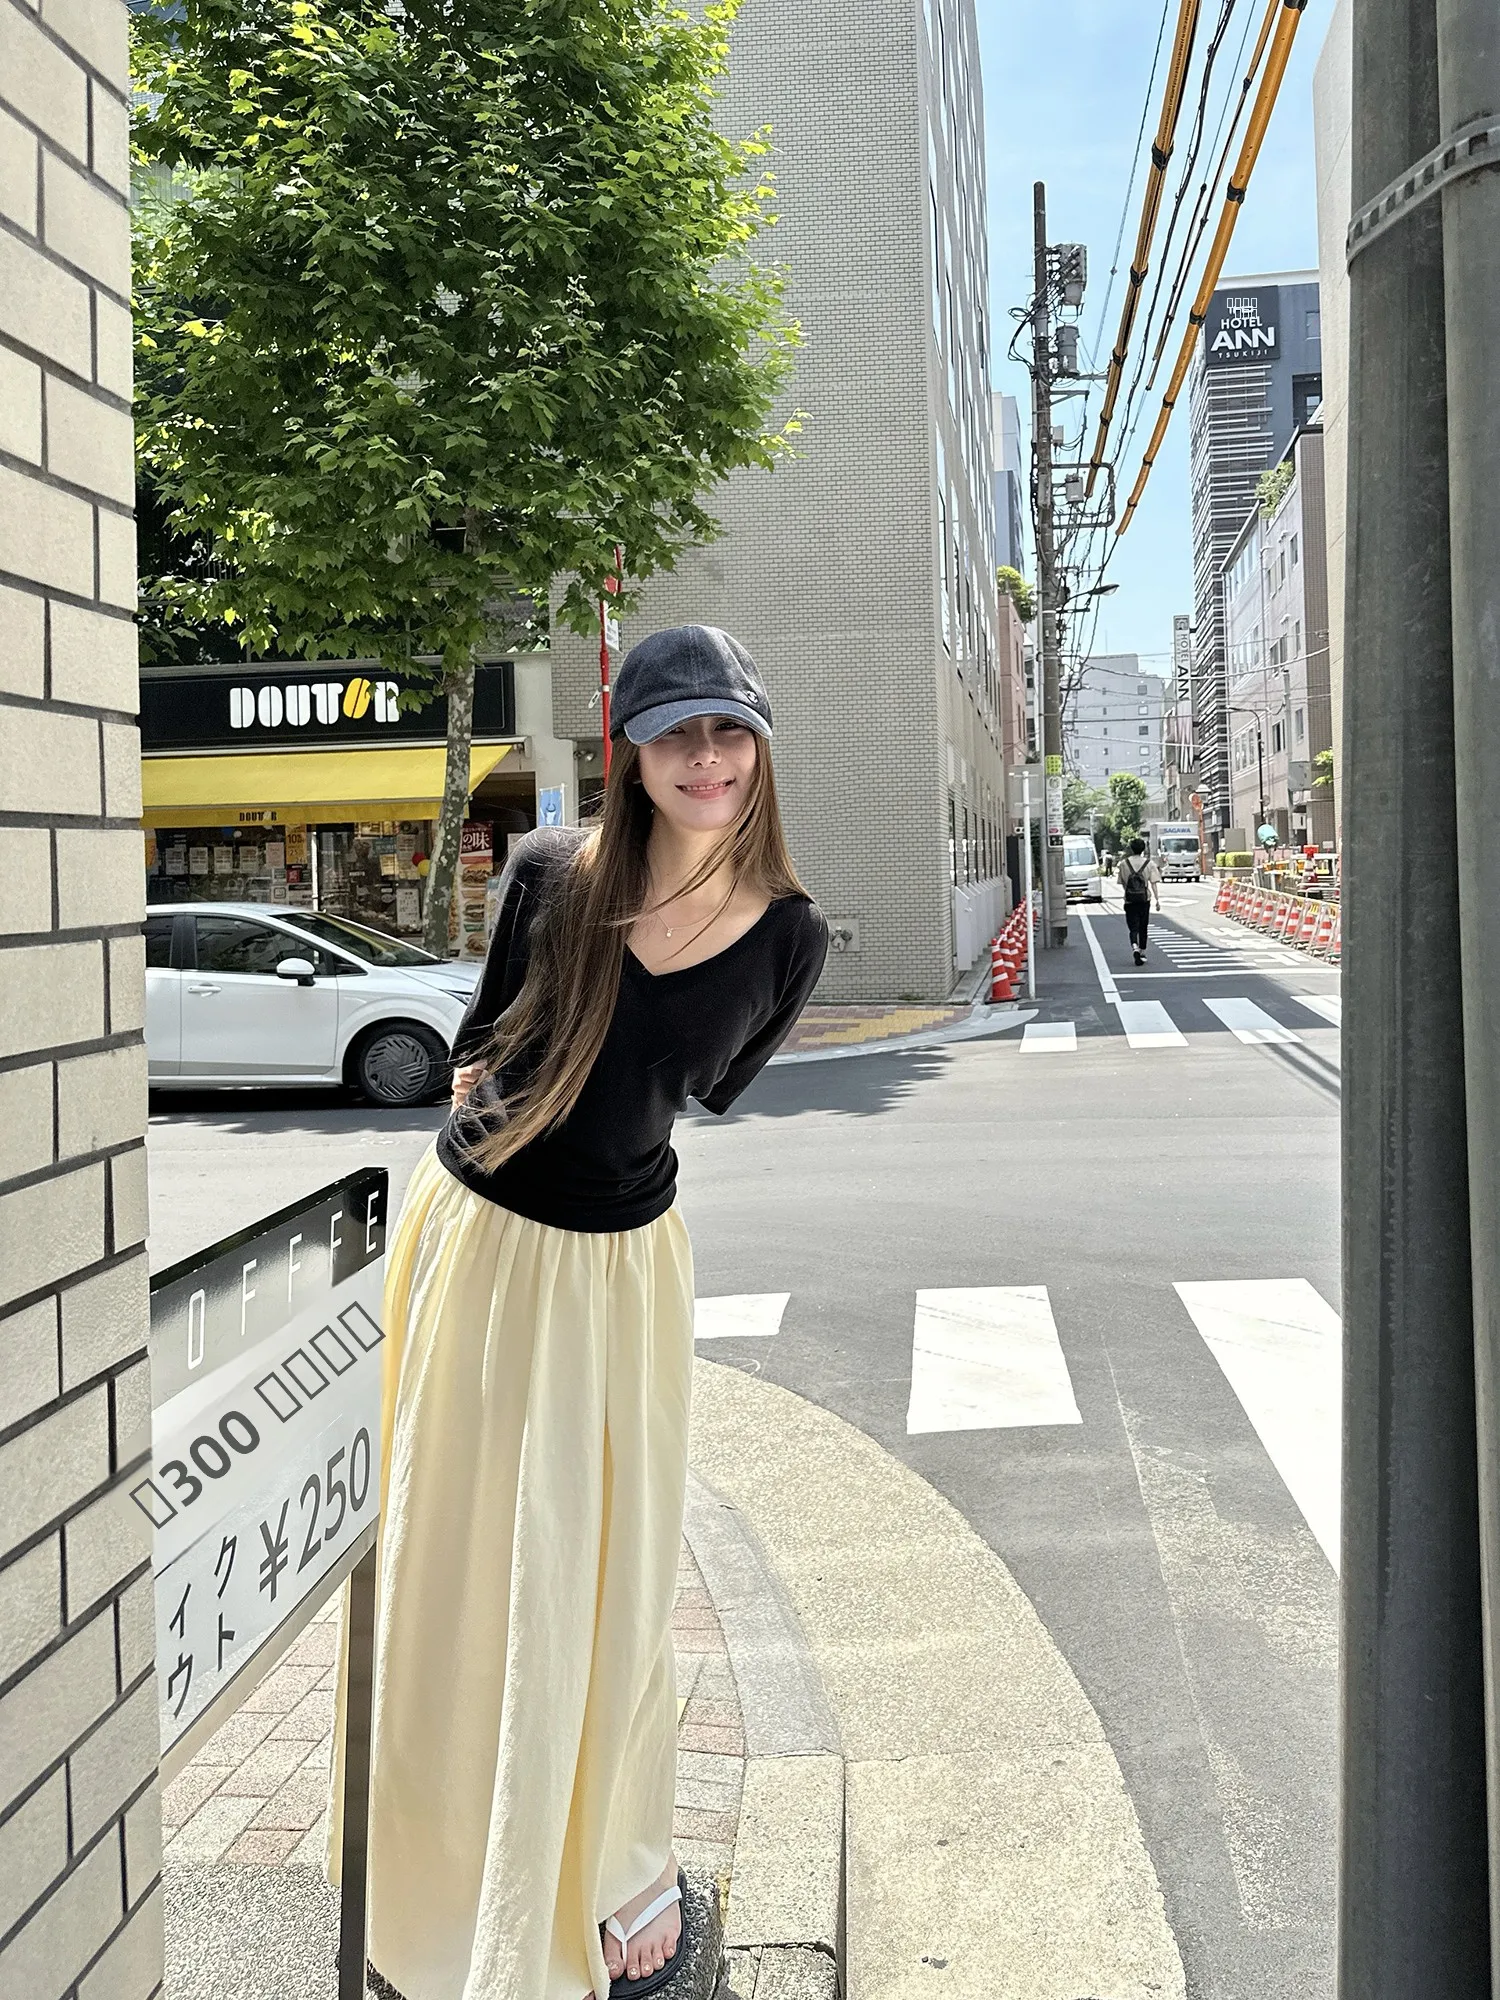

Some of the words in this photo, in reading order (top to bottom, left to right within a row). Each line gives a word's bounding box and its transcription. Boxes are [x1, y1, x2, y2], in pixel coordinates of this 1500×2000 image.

[1221, 315, 1263, 330] HOTEL
[1210, 327, 1275, 352] ANN
[1218, 349, 1268, 359] TSUKIJI
[1180, 633, 1188, 664] HOTEL
[1177, 665, 1189, 701] ANN
[229, 677, 399, 729] DOUTOR
[258, 1426, 371, 1603] ¥250
